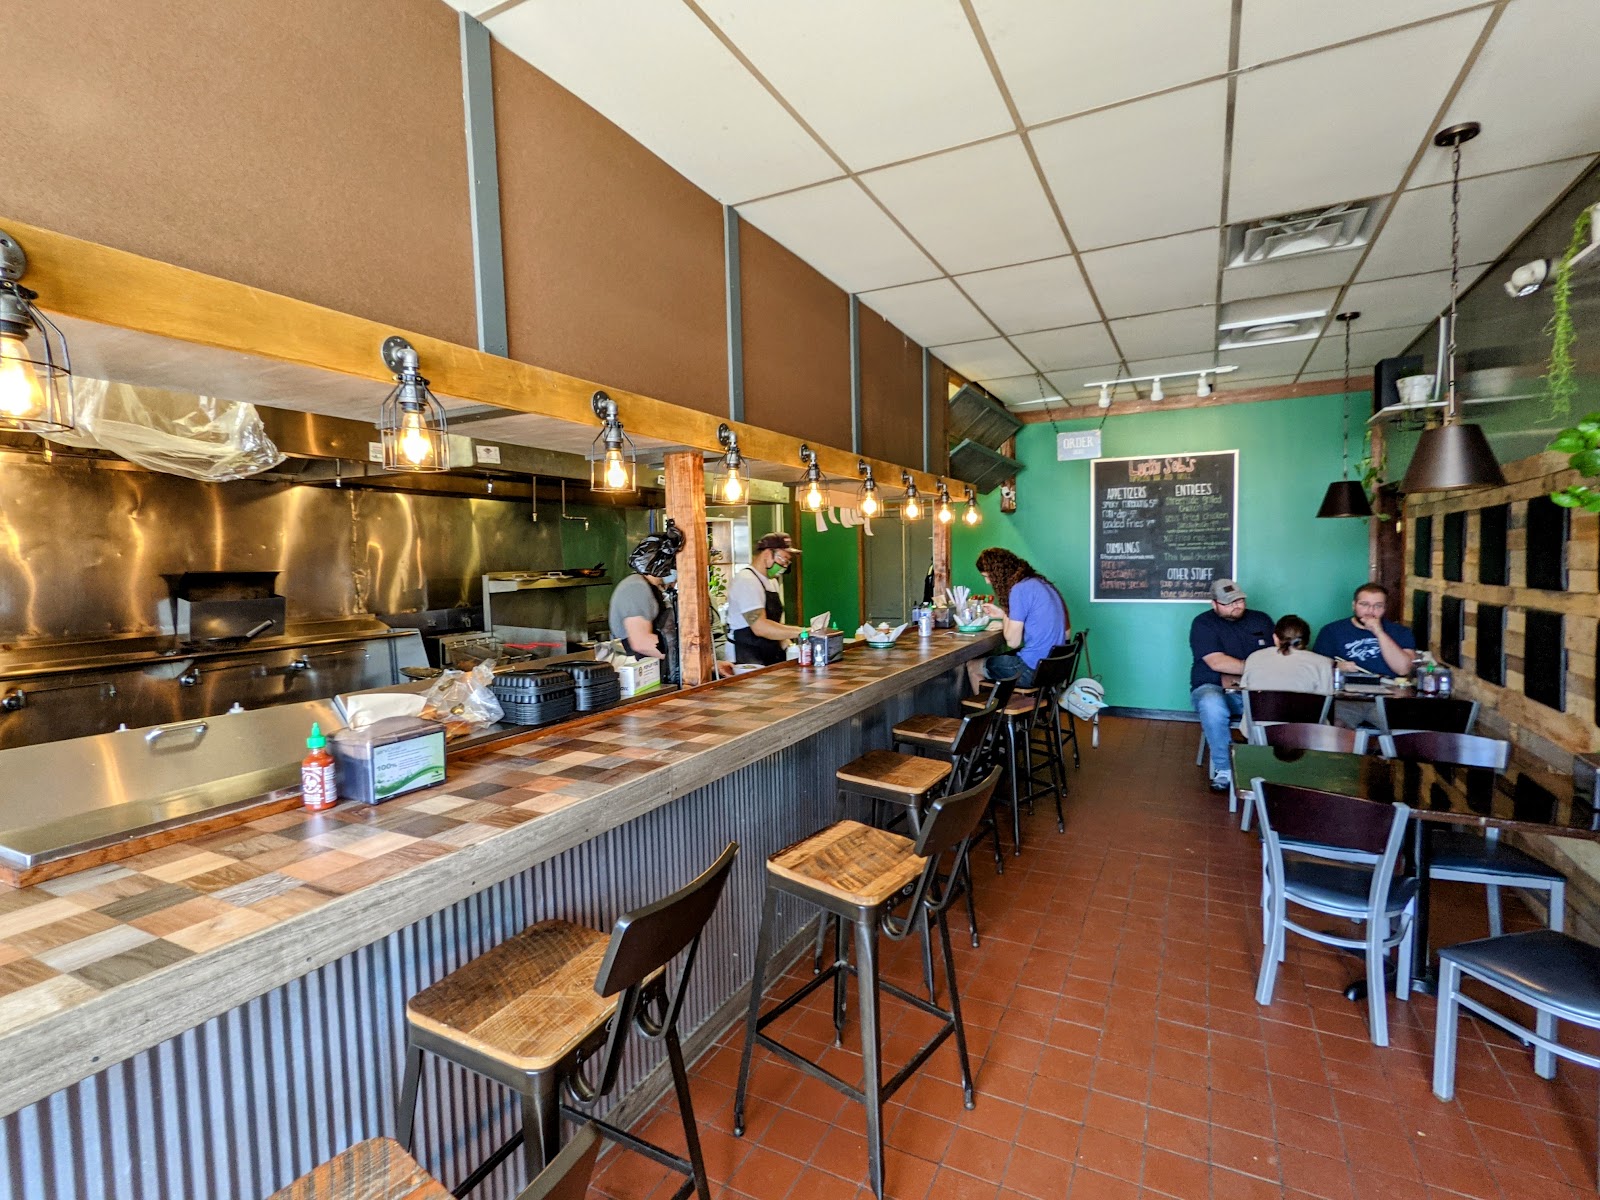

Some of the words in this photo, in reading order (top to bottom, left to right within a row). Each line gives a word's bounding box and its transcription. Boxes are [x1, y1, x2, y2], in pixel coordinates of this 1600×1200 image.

[1063, 436, 1095, 449] ORDER
[1175, 483, 1213, 497] ENTREES
[1105, 541, 1141, 554] DUMPLINGS
[1167, 568, 1190, 580] OTHER
[1191, 567, 1214, 580] STUFF
